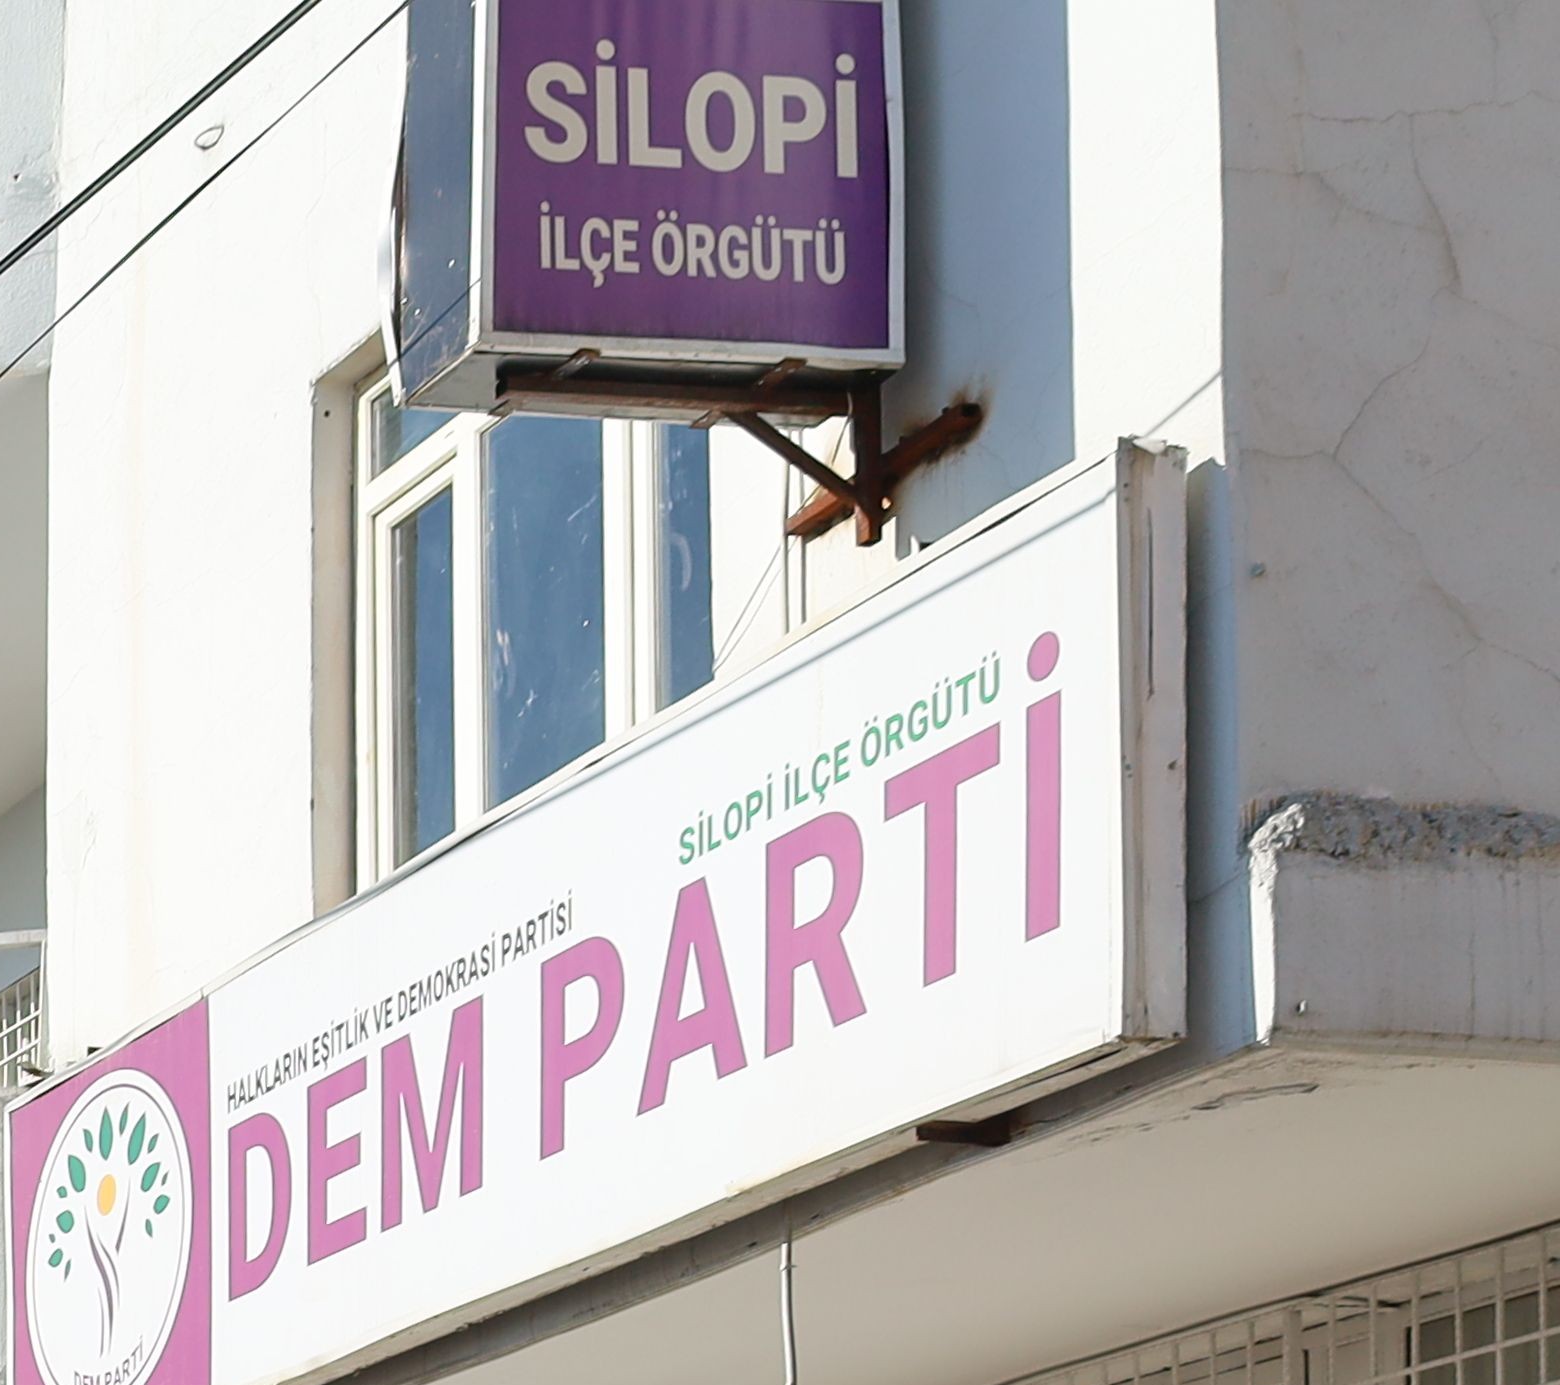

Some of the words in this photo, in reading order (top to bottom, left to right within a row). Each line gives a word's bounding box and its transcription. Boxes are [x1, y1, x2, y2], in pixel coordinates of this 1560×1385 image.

[524, 38, 860, 180] SİLOPİ
[539, 200, 641, 289] İLÇE
[651, 208, 847, 286] ÖRGÜTÜ
[678, 772, 773, 866] SİLOPİ
[784, 740, 852, 806] İLÇE
[860, 650, 1001, 769] ÖRGÜTÜ
[226, 1040, 309, 1115] HALKLARIN
[311, 1005, 371, 1072] EŞİTLİK
[373, 995, 394, 1035] VE
[397, 931, 498, 1024] DEMOKRASİ
[501, 888, 574, 969] PARTİSİ
[227, 993, 484, 1305] DEM
[539, 630, 1062, 1161] PARTİ
